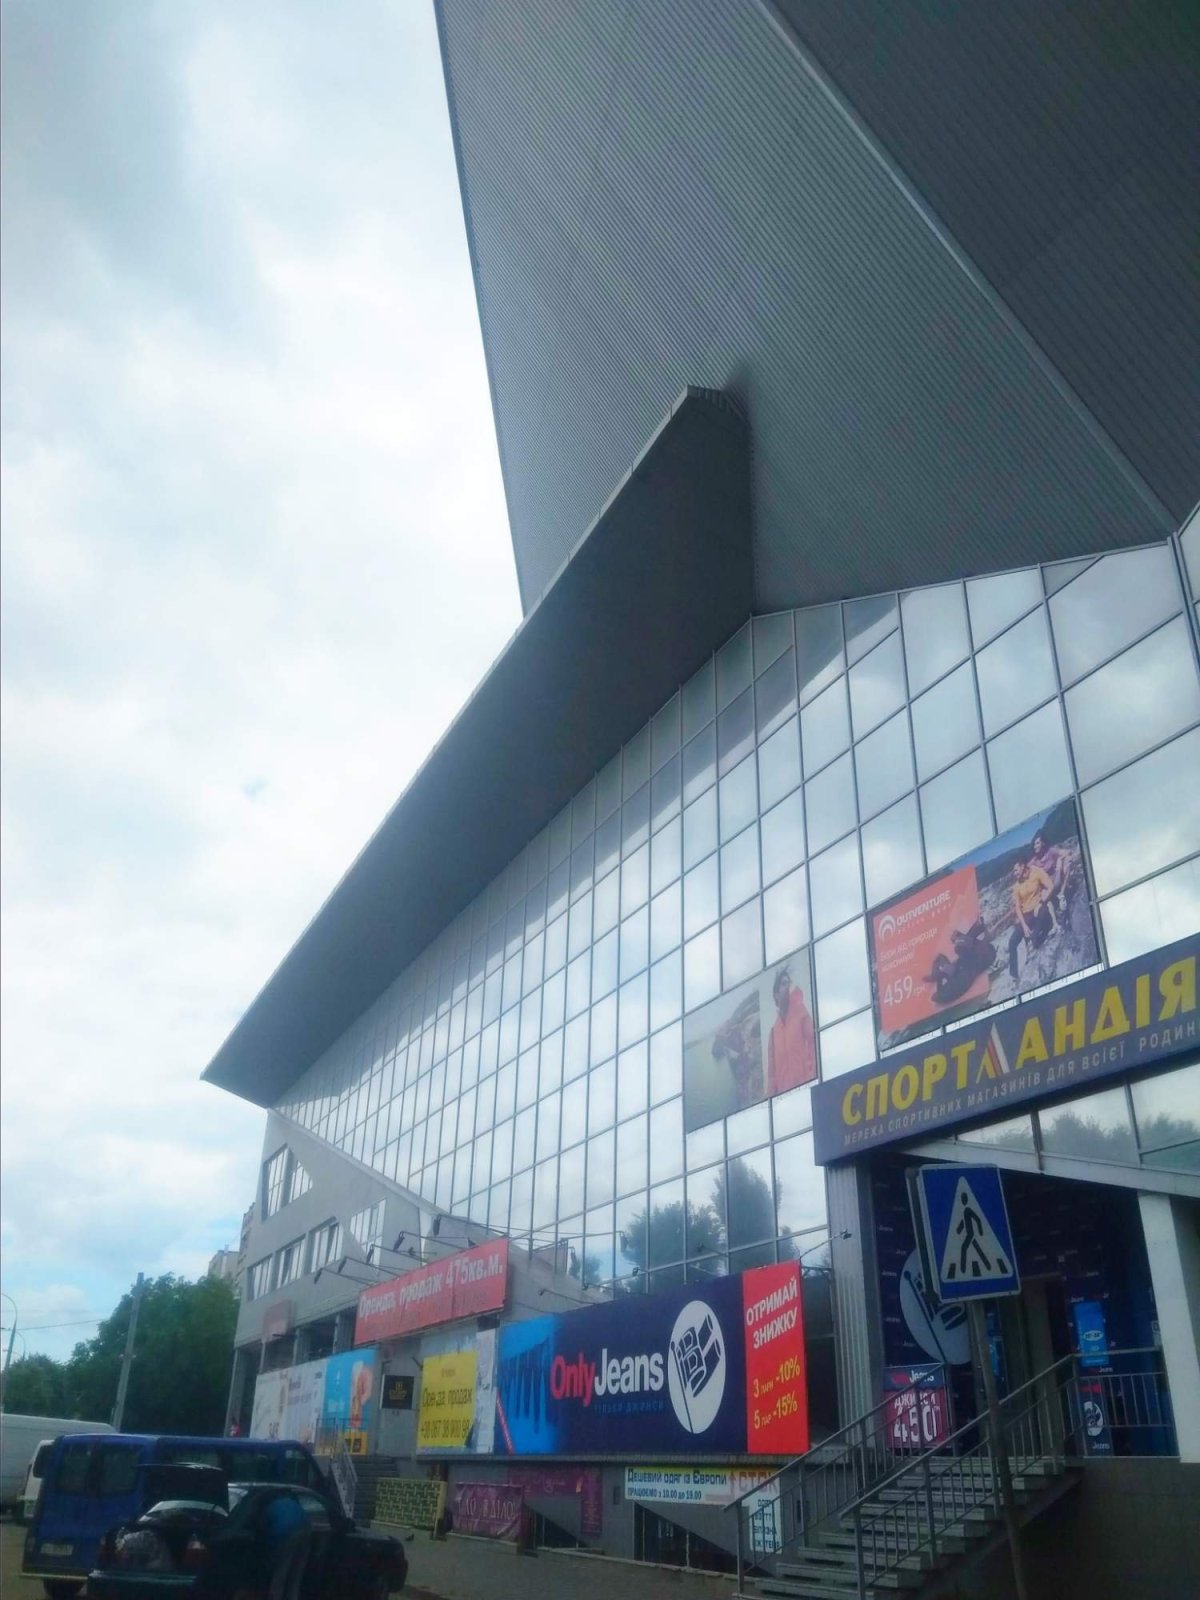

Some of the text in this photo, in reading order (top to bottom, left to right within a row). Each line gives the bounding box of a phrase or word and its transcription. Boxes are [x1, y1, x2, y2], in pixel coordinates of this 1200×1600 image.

[896, 889, 951, 926] OUTVENTURE
[883, 975, 914, 1007] 459
[842, 955, 1197, 1127] СПОРТЛАНДІЯ
[844, 1019, 1200, 1146] МЕРЕЖА СПОРТИВНИХ МАГАЗИНІВ ДЛЯ ВСІЄЇ РОДИН
[400, 1272, 443, 1311] продаж
[746, 1275, 798, 1326] ОТРИМАЙ
[753, 1307, 798, 1350] ЗНИЖКУ
[753, 1378, 760, 1399] 3
[776, 1355, 801, 1385] -10%
[754, 1409, 761, 1430] 5
[773, 1391, 798, 1418] -15%
[663, 1488, 678, 1498] 10.00
